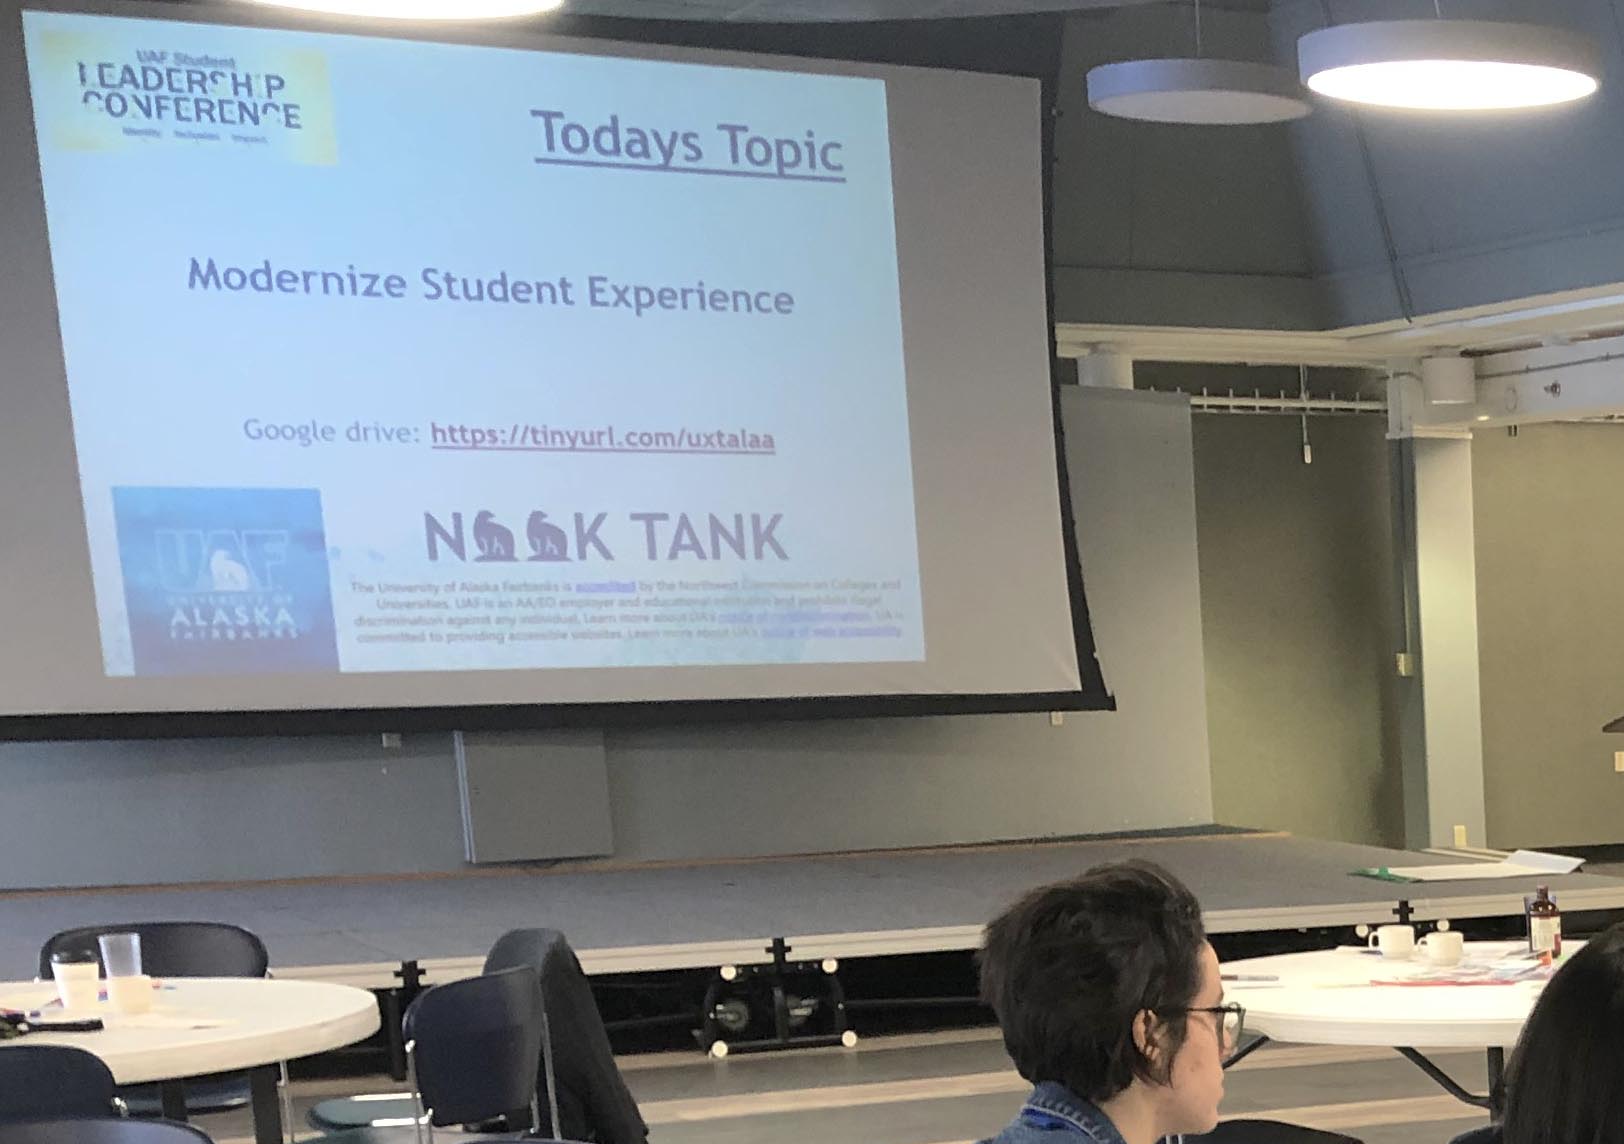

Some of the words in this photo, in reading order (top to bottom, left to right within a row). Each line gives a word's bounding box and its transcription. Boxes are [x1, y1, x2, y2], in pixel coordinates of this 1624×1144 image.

[77, 61, 285, 99] LEADERSHP
[530, 109, 702, 167] Todays
[717, 123, 844, 175] Topic
[188, 257, 407, 299] Modernize
[423, 266, 575, 306] Student
[588, 275, 795, 317] Experience
[243, 418, 336, 447] Google
[346, 421, 420, 443] drive:
[431, 421, 776, 454] https://tinyurl.com/uxtalaa
[424, 509, 614, 563] NK
[629, 512, 790, 562] TANK
[171, 607, 297, 627] ALASKA
